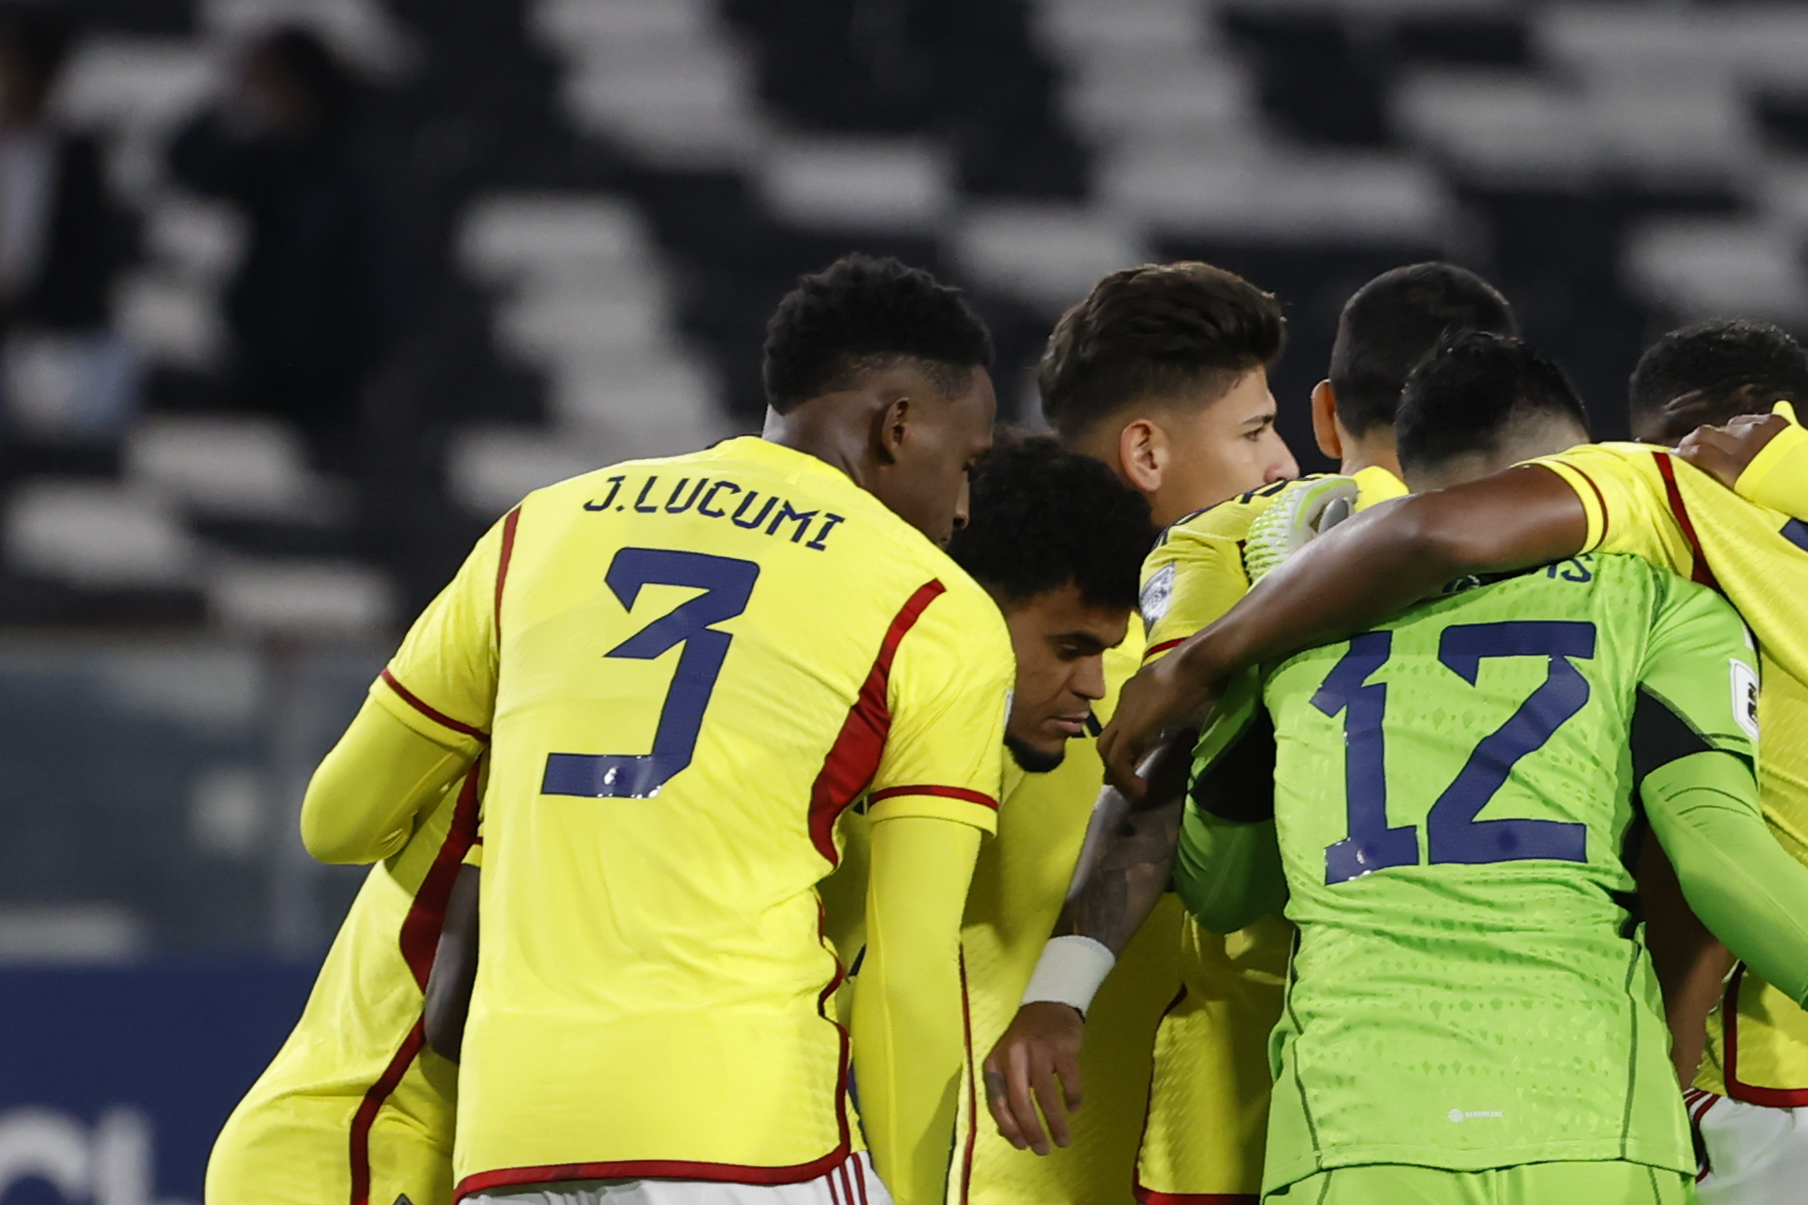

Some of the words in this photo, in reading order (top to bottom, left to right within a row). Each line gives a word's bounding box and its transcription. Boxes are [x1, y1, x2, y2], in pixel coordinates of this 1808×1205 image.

[584, 475, 846, 551] J.LUCUMI
[541, 546, 761, 799] 3
[1309, 620, 1596, 886] 12
